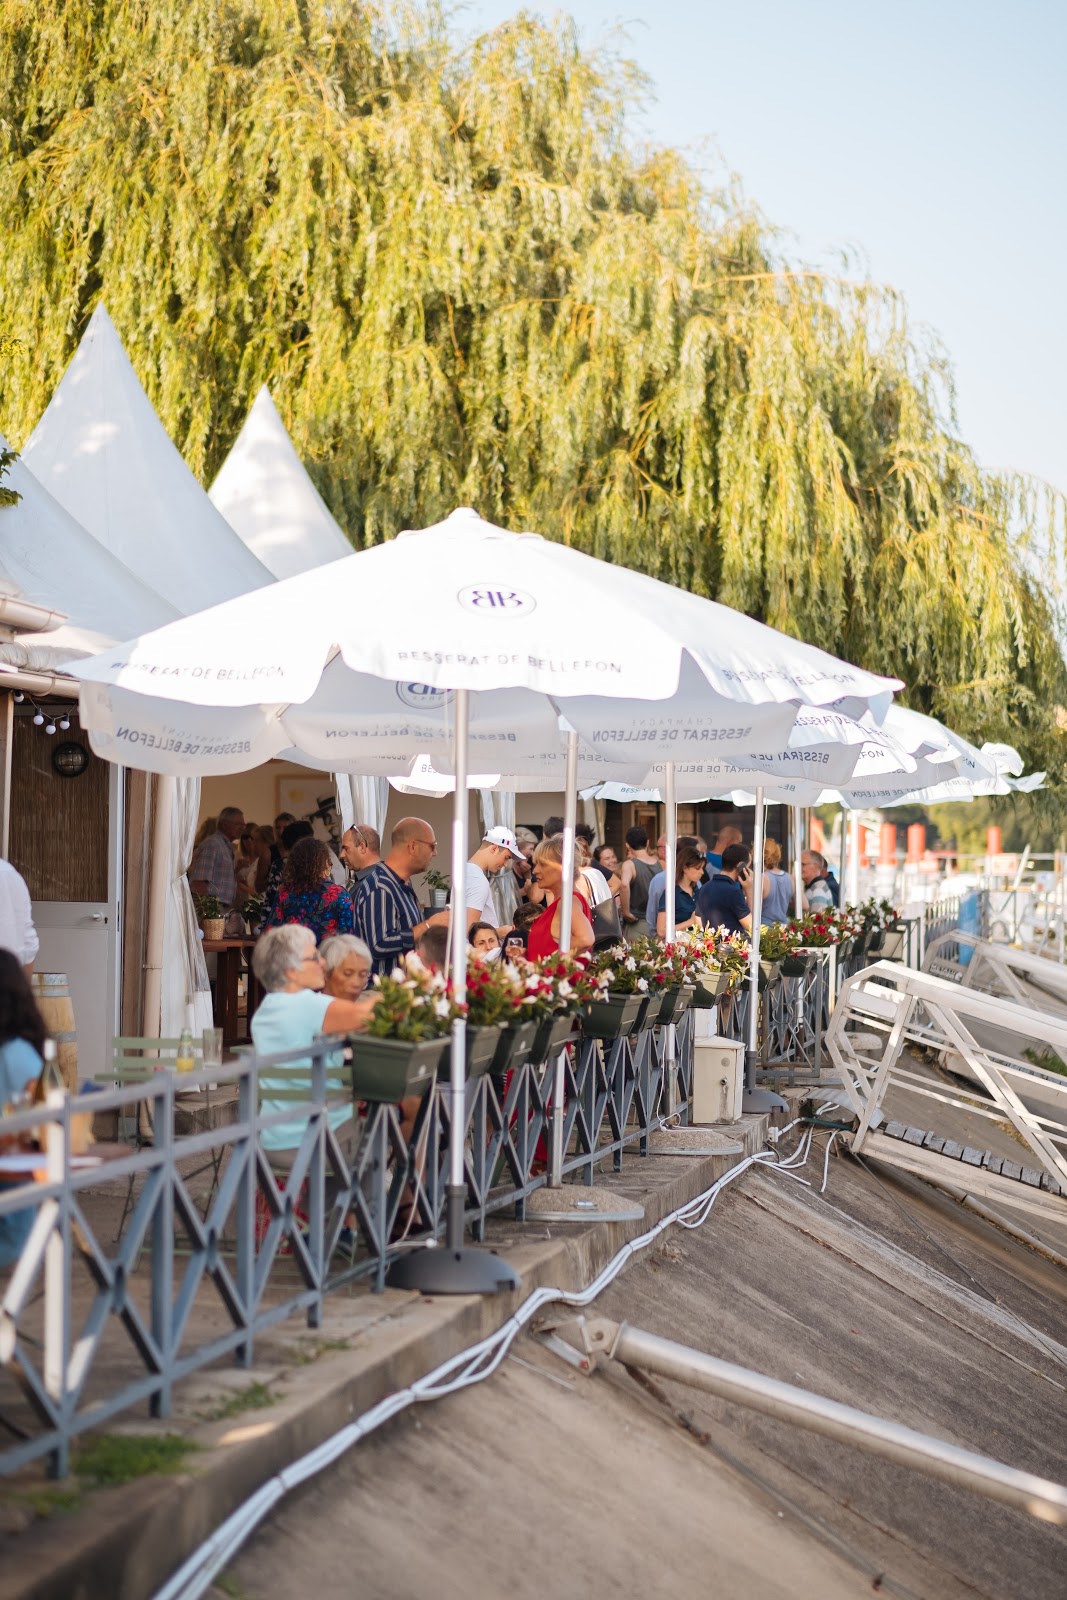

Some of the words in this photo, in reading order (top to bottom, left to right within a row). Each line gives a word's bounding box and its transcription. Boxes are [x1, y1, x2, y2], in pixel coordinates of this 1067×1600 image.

[397, 650, 491, 668] BESSERAT
[497, 653, 521, 666] DE
[527, 653, 622, 673] BELLEFON
